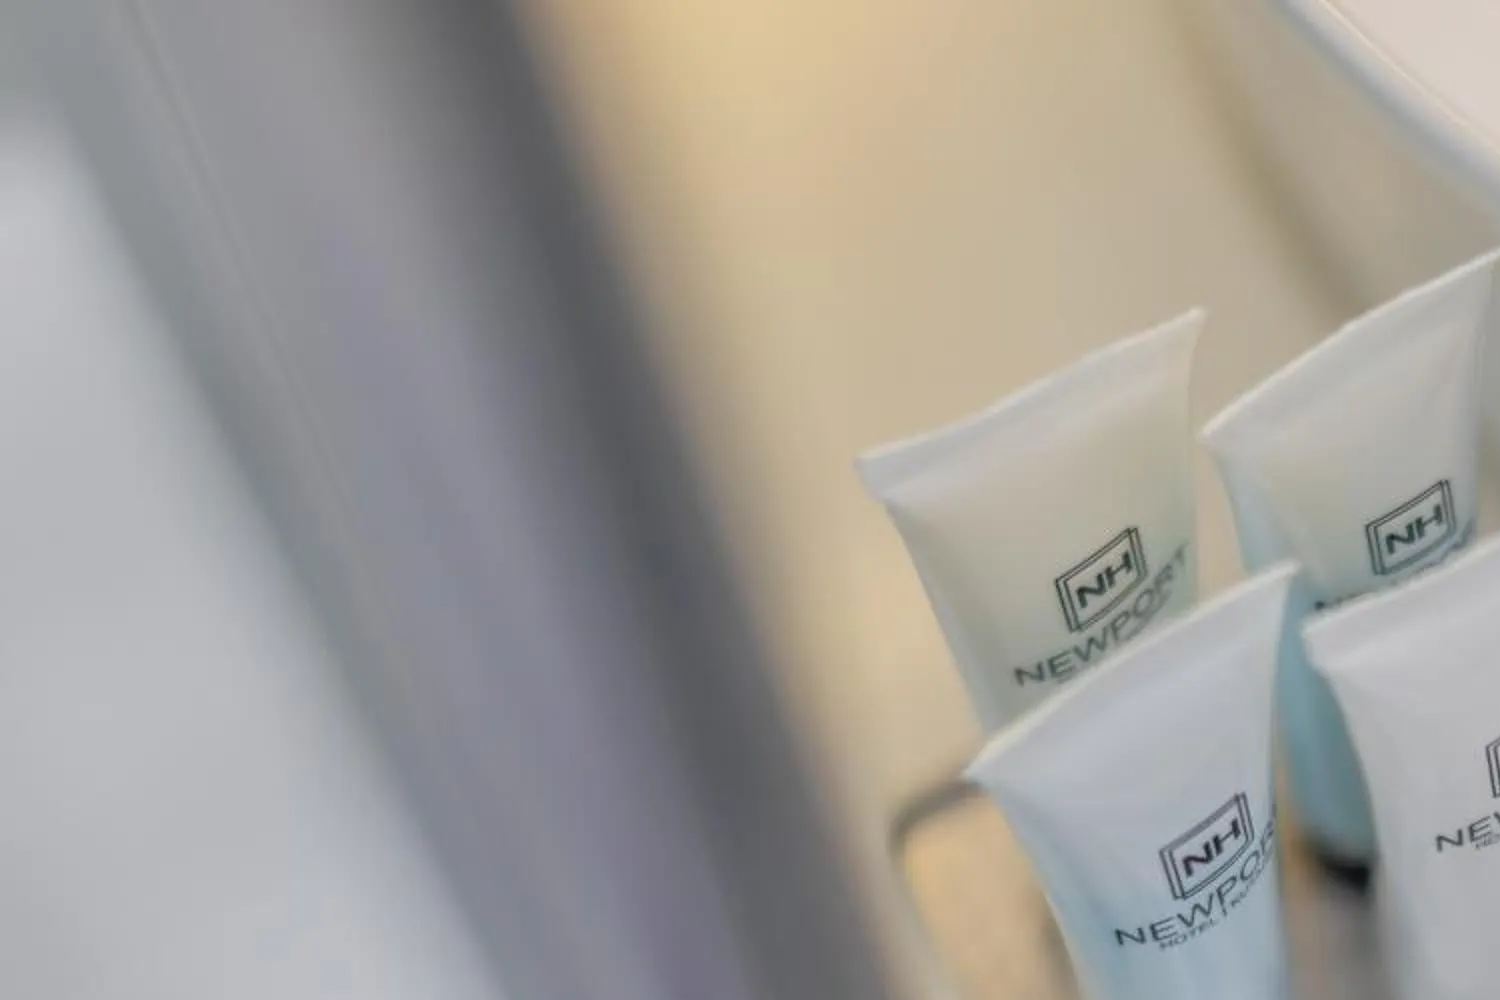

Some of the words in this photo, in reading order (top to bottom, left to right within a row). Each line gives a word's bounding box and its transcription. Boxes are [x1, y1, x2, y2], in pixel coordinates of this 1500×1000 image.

[1387, 504, 1443, 555] NH
[1075, 550, 1133, 608] NH
[1013, 541, 1189, 687] NEWPORT
[1182, 818, 1242, 878] NH
